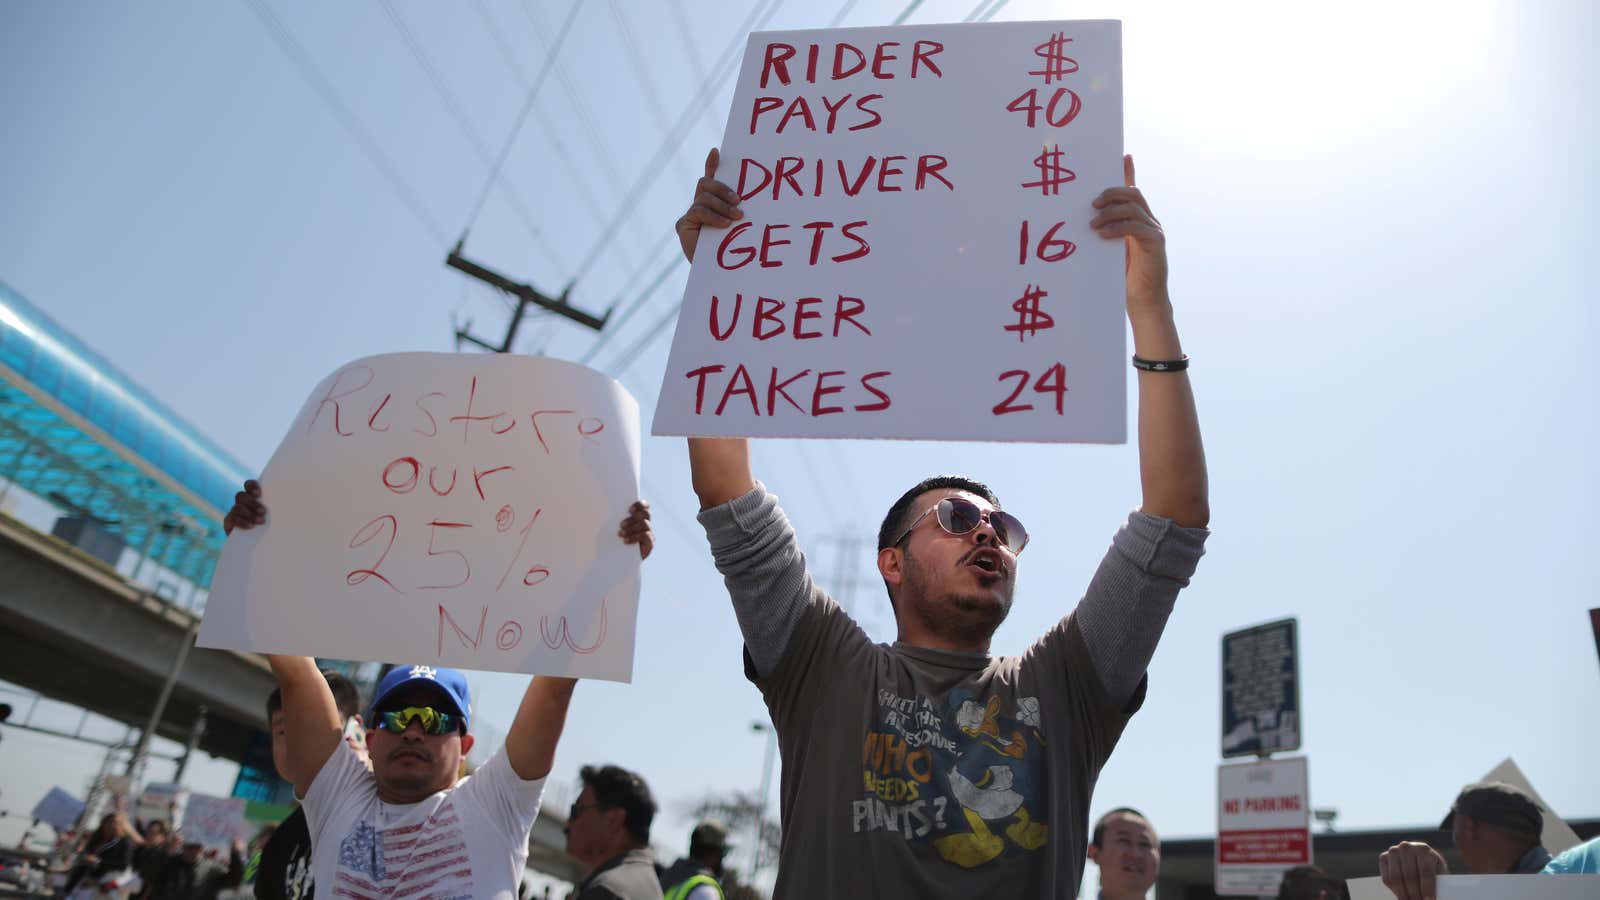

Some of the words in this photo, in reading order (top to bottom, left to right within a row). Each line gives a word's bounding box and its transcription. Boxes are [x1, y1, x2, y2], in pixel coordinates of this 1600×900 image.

[760, 40, 945, 88] RIDER
[1028, 31, 1080, 84] $
[750, 94, 884, 134] PAYS
[1006, 88, 1082, 128] 40
[738, 155, 954, 200] DRIVER
[1022, 144, 1077, 195] $
[716, 220, 871, 270] GETS
[1019, 221, 1076, 264] 16
[708, 294, 872, 340] UBER
[1004, 284, 1055, 341] $
[686, 364, 892, 416] TAKES
[992, 362, 1068, 416] 24
[345, 504, 551, 593] 25%
[1244, 794, 1301, 815] PARKING
